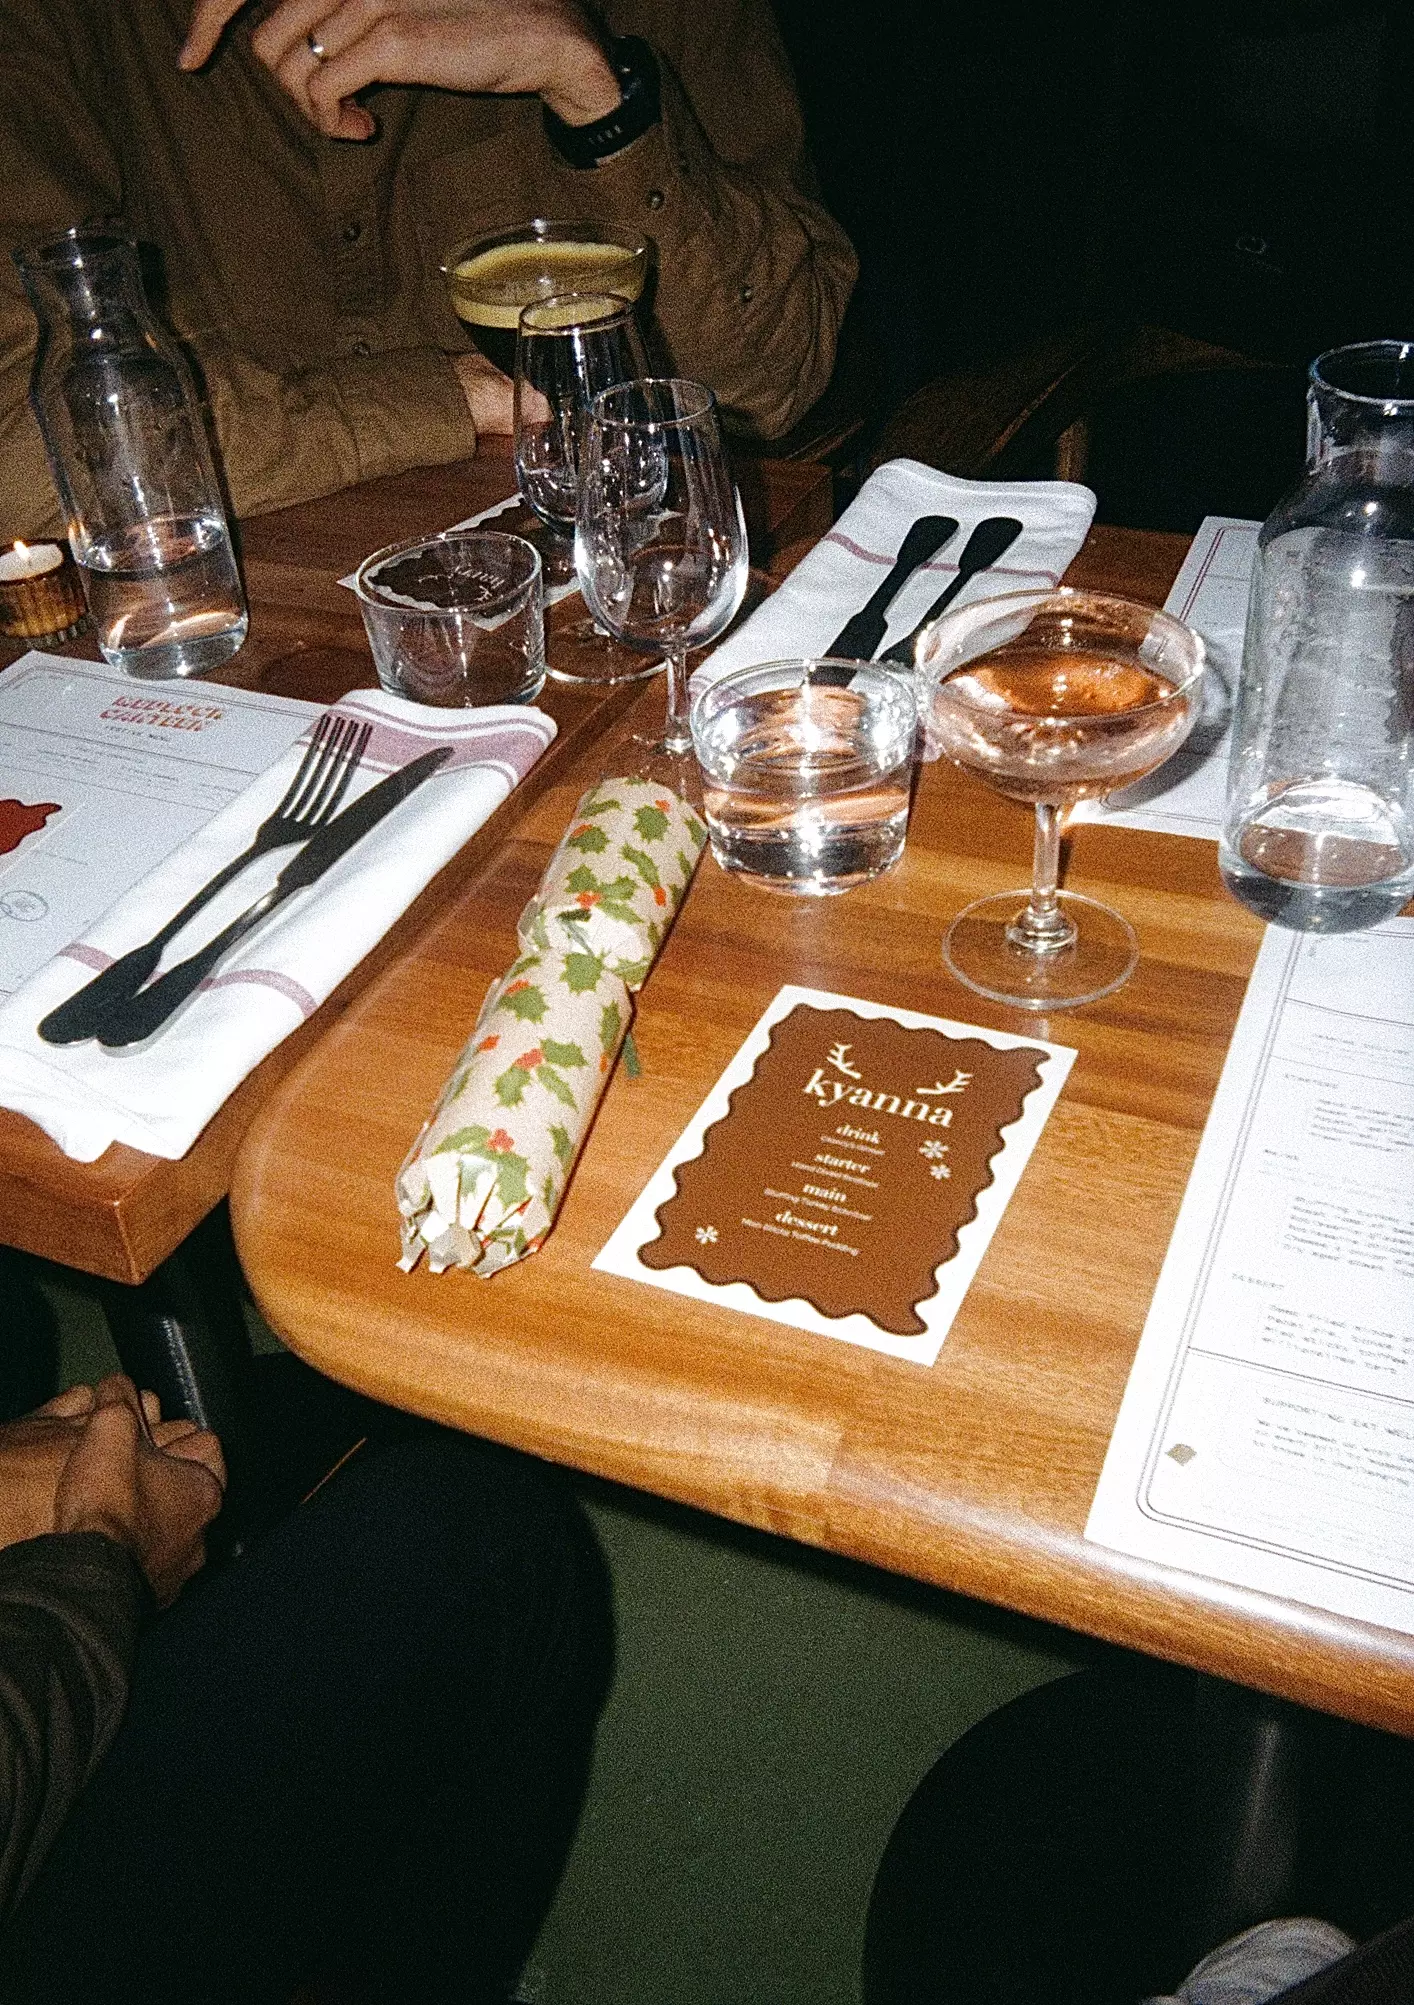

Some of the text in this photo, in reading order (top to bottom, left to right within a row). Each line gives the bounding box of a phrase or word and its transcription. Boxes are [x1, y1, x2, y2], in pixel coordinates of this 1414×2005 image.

[803, 1069, 954, 1127] kyanna
[835, 1123, 880, 1144] drink
[814, 1153, 871, 1174] starter
[802, 1183, 847, 1203] main
[775, 1210, 839, 1236] dessert
